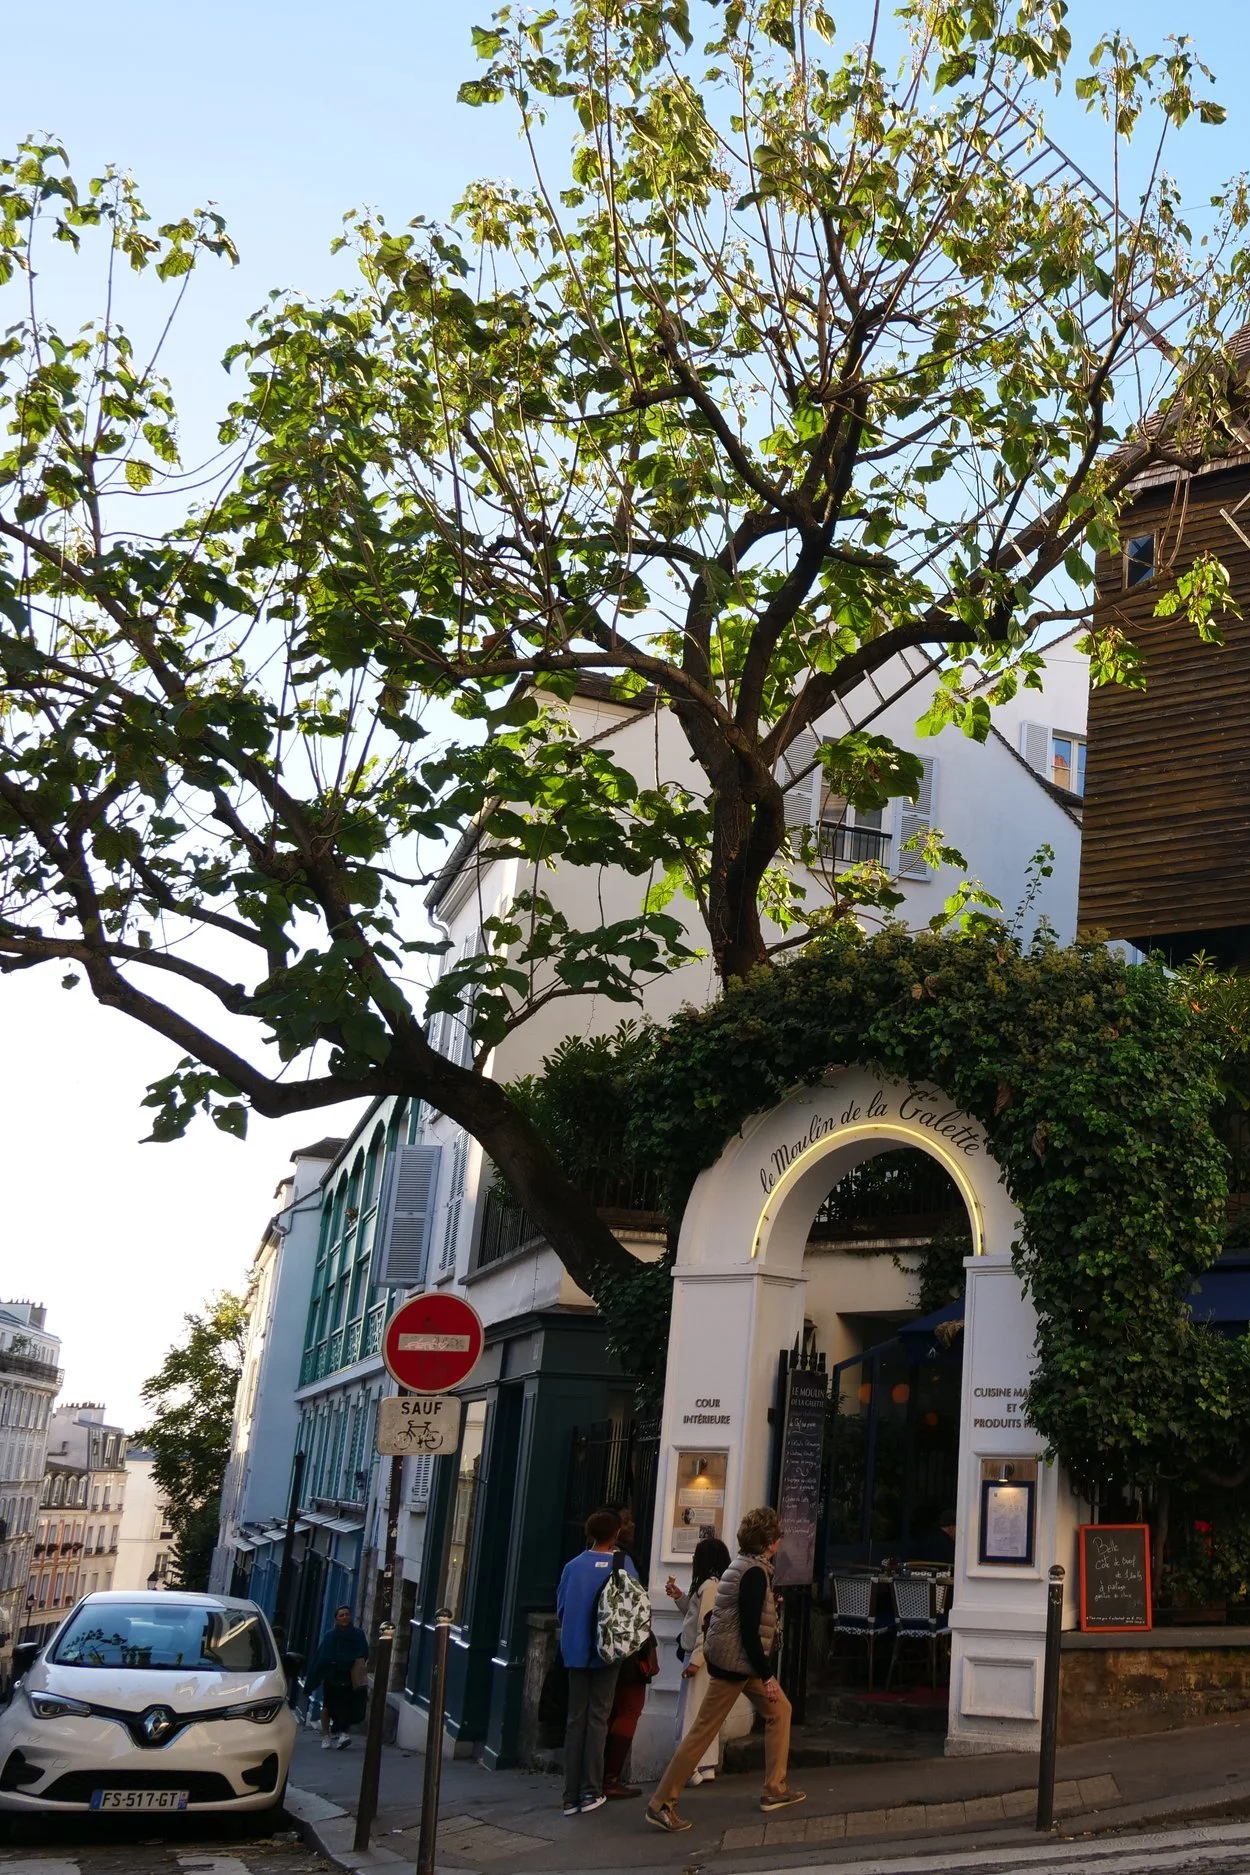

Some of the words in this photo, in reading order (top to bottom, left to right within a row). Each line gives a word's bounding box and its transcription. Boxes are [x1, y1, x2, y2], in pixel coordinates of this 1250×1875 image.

[760, 1168, 776, 1194] le
[770, 1114, 836, 1175] Moulin
[841, 1100, 861, 1125] de
[866, 1090, 888, 1118] la
[899, 1088, 981, 1157] Galette
[792, 1386, 799, 1396] LE
[800, 1387, 825, 1399] MOULIN
[974, 1388, 1012, 1398] CUISINE
[401, 1401, 443, 1415] SAUF
[695, 1398, 721, 1408] COUR
[1006, 1403, 1018, 1413] ET
[683, 1413, 731, 1425] INTÉRIEURE
[974, 1419, 1021, 1429] PRODUITS
[102, 1792, 178, 1807] FS-517-GT
